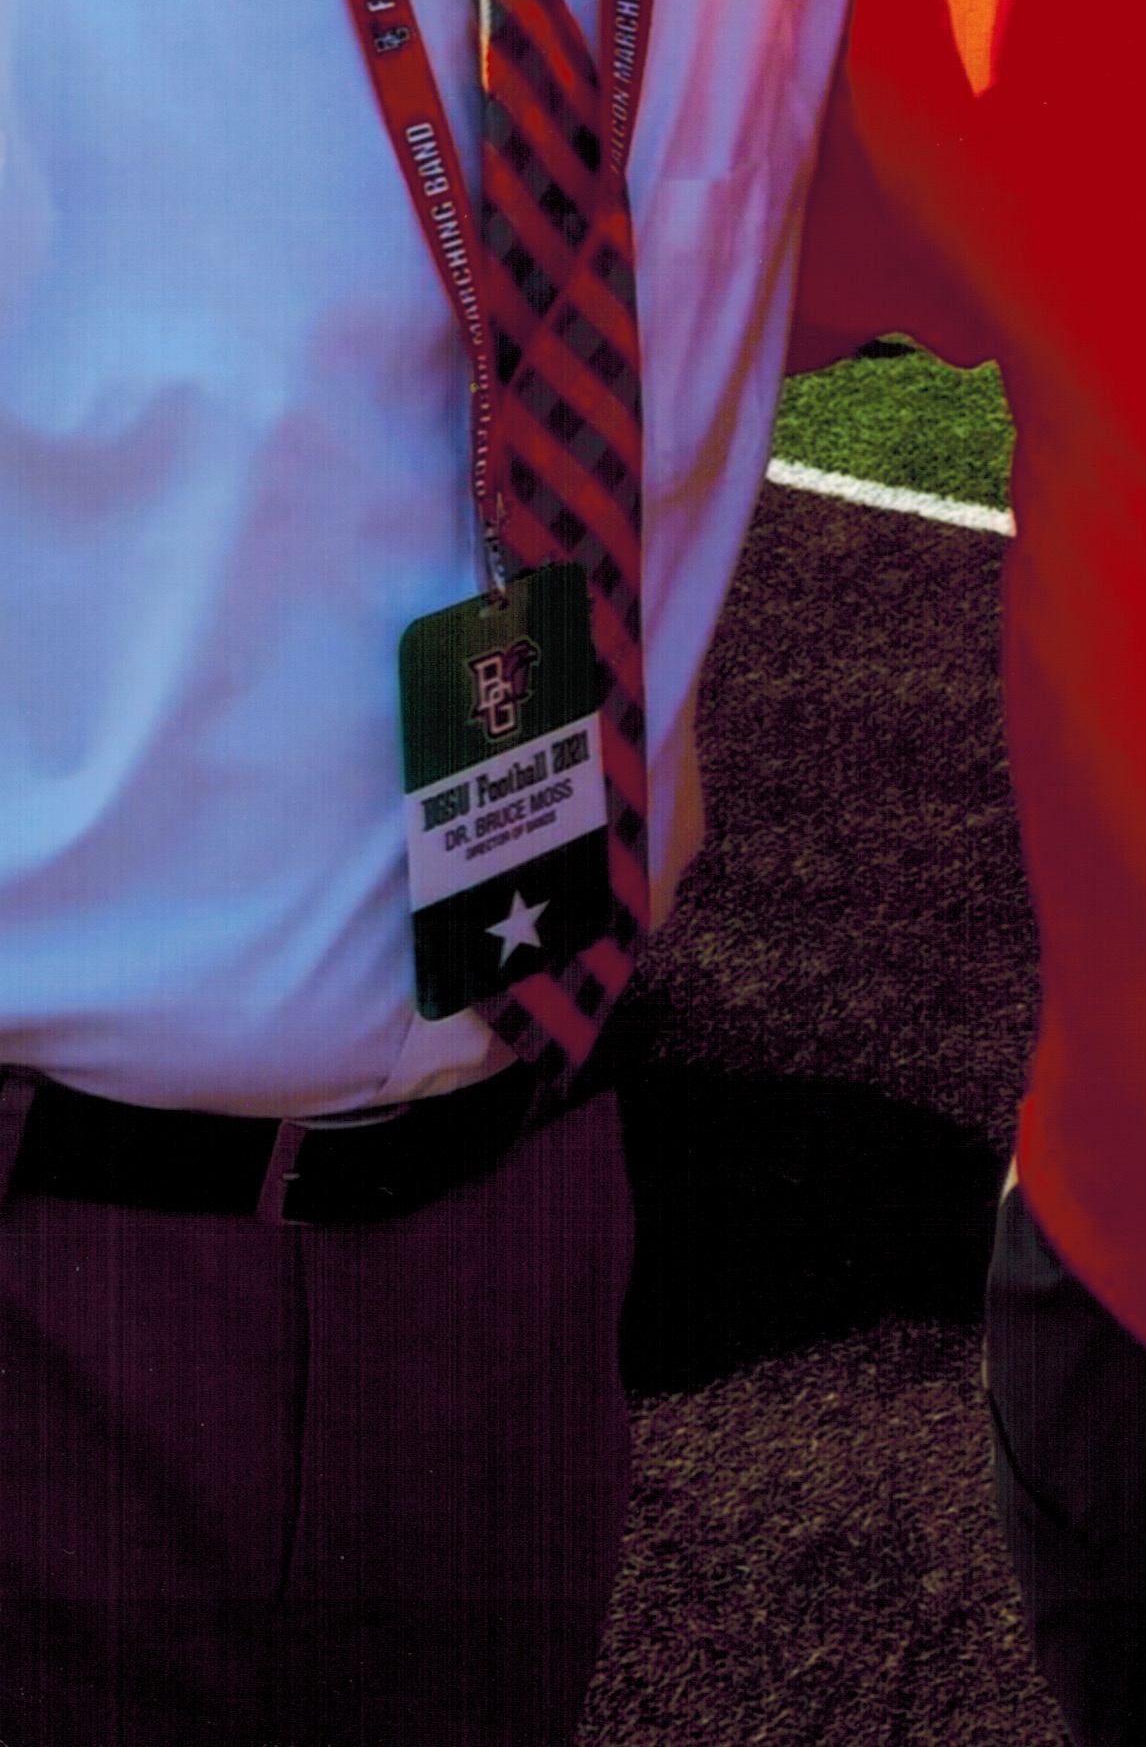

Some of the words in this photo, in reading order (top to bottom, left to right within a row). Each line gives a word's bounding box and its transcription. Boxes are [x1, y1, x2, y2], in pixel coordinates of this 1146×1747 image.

[405, 121, 450, 197] BAND
[431, 198, 484, 346] MARCHING
[444, 824, 471, 852] DR.
[475, 798, 527, 839] BRUCE
[530, 777, 575, 815] MOSS
[475, 750, 549, 809] Football
